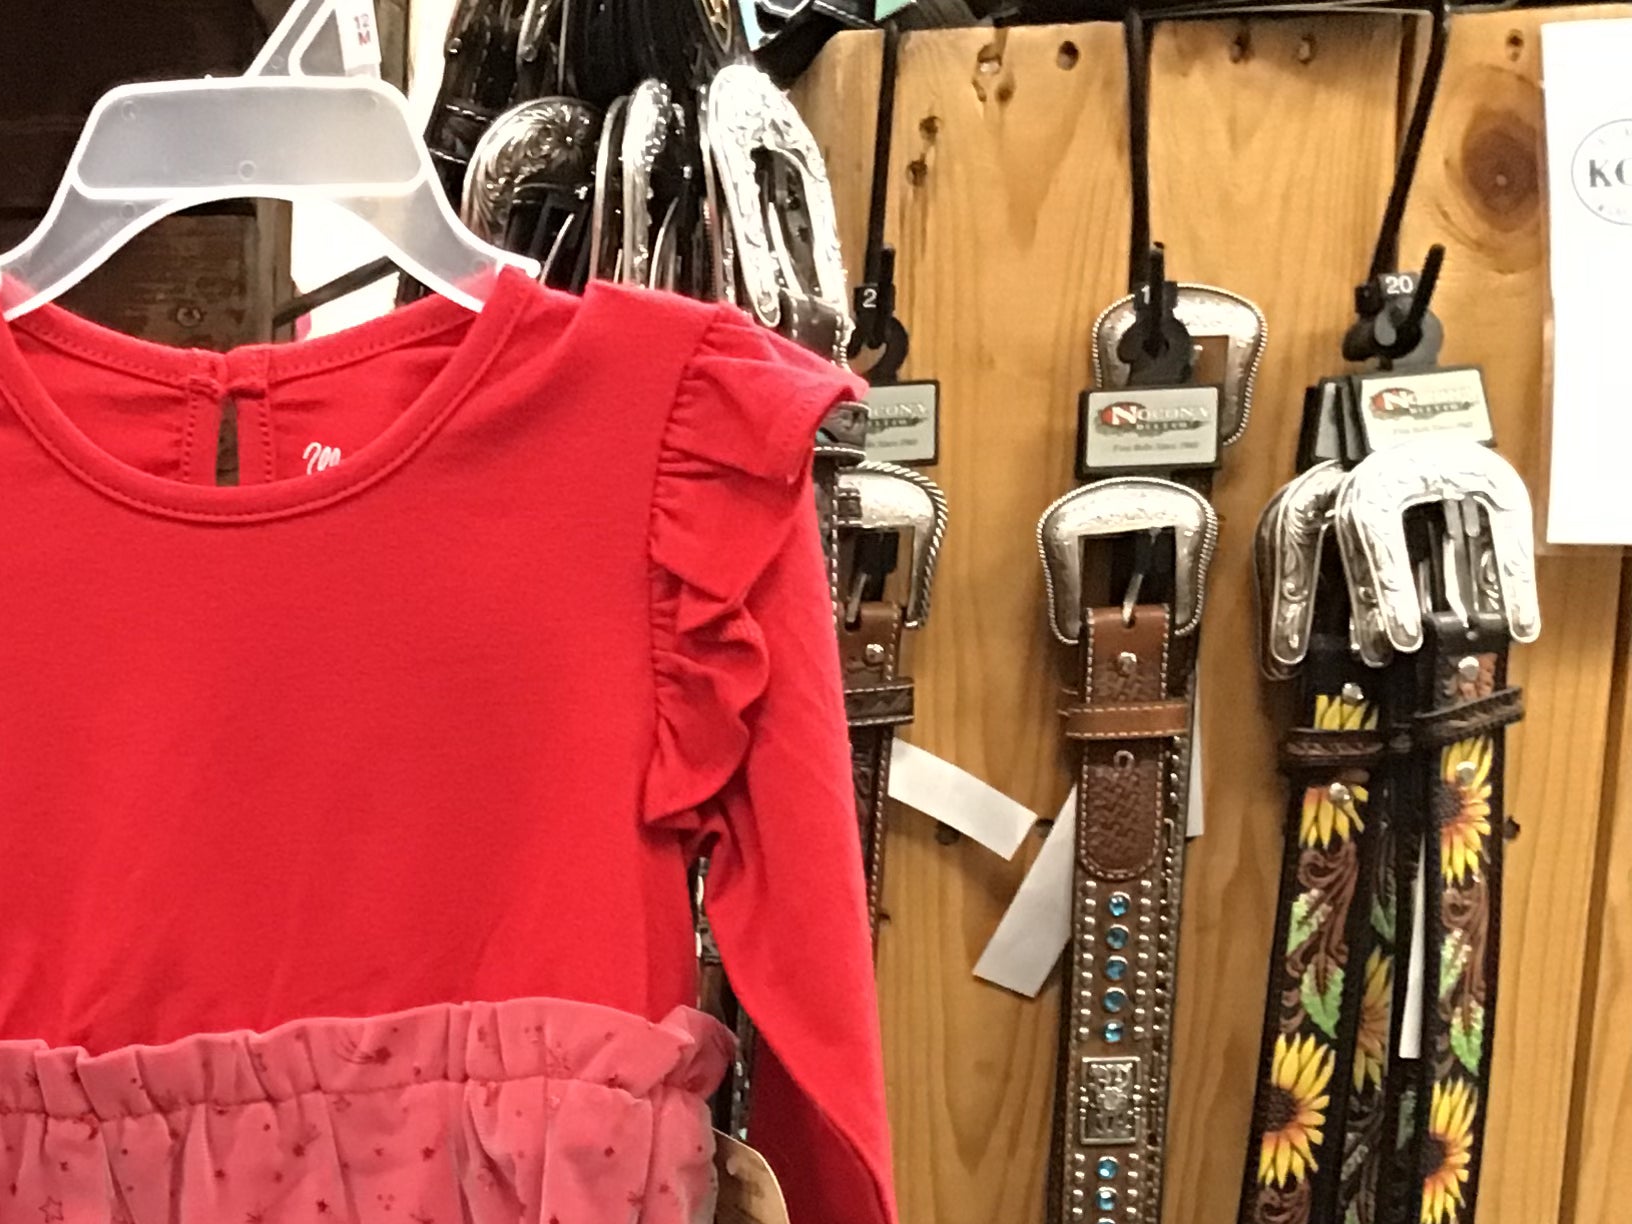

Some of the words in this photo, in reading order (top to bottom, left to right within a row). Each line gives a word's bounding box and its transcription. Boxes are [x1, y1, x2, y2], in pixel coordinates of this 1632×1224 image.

[353, 13, 370, 29] 12
[358, 30, 371, 46] M
[1384, 274, 1415, 295] 20
